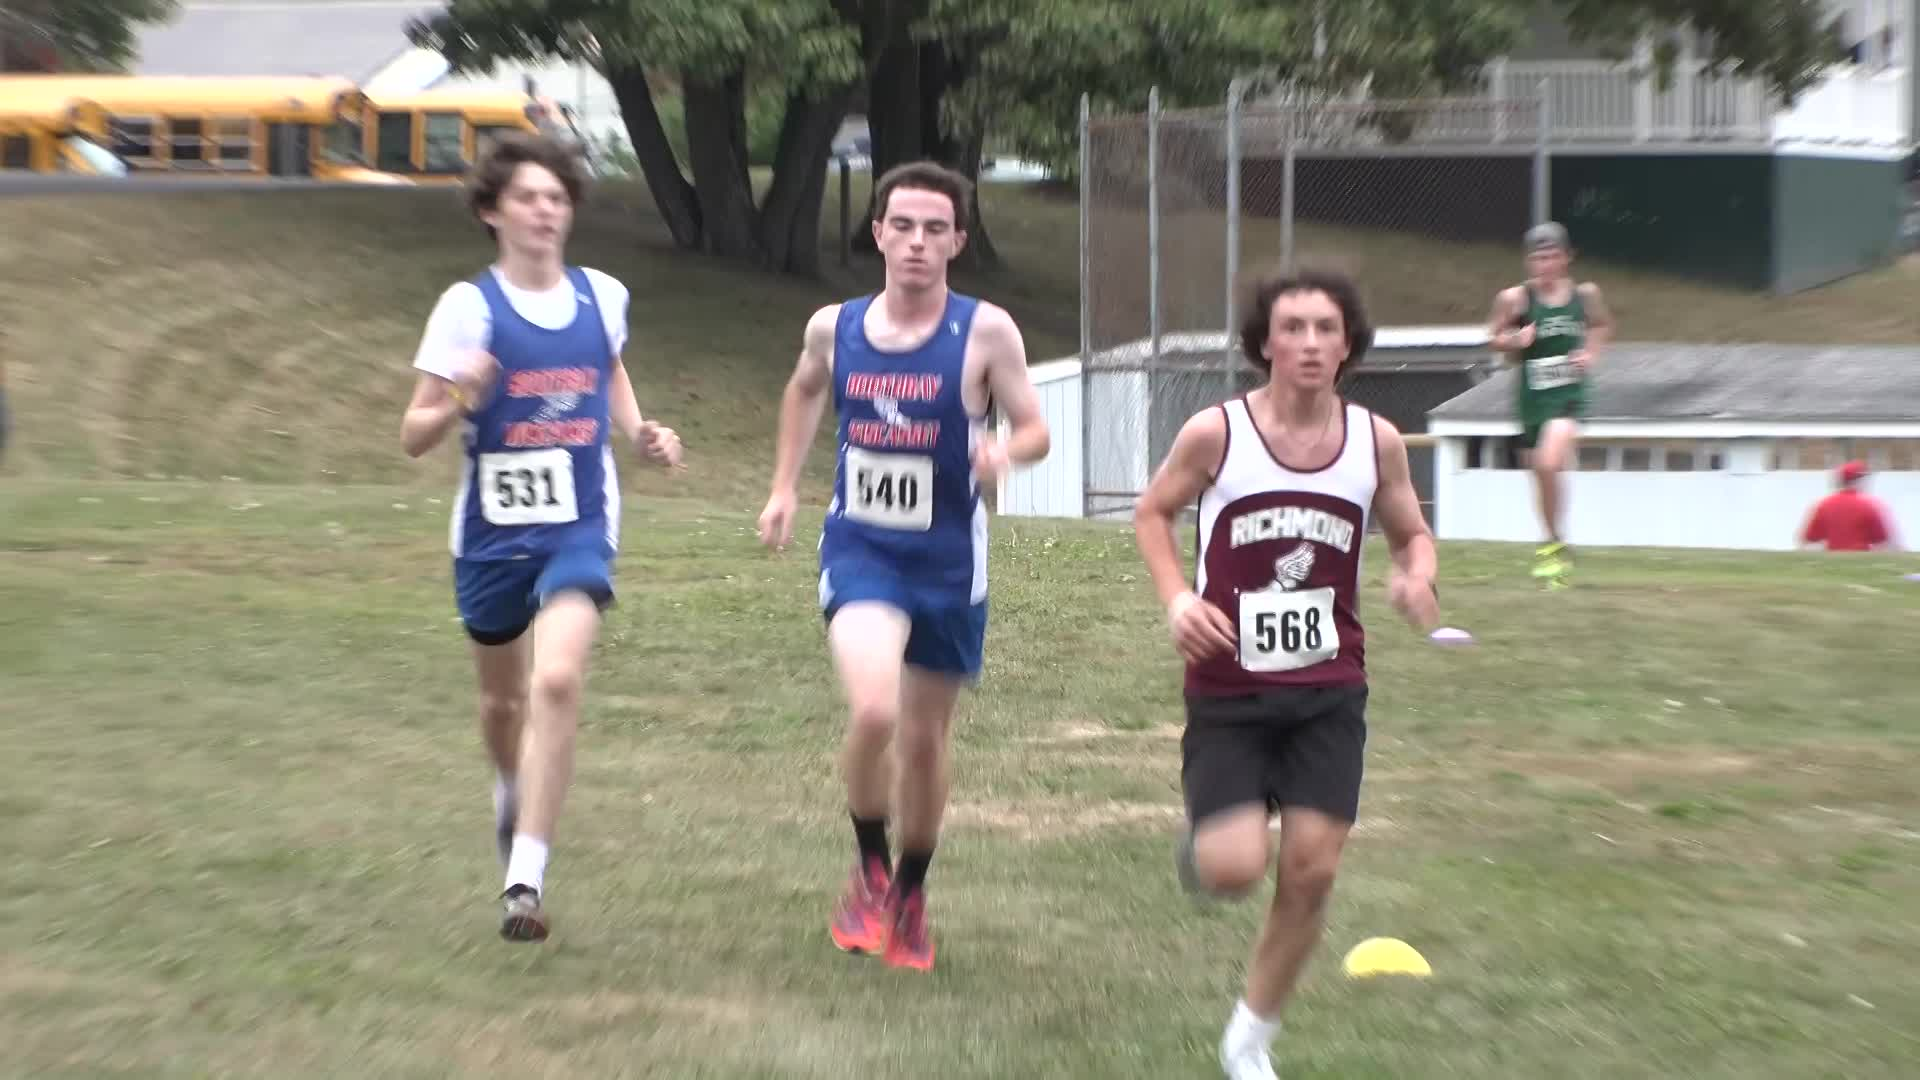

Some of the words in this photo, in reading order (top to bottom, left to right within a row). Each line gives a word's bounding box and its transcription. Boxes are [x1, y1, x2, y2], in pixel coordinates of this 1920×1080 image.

[495, 467, 560, 508] 531
[858, 469, 918, 512] 540
[1230, 506, 1354, 553] RICHMOND
[1256, 607, 1322, 653] 568
